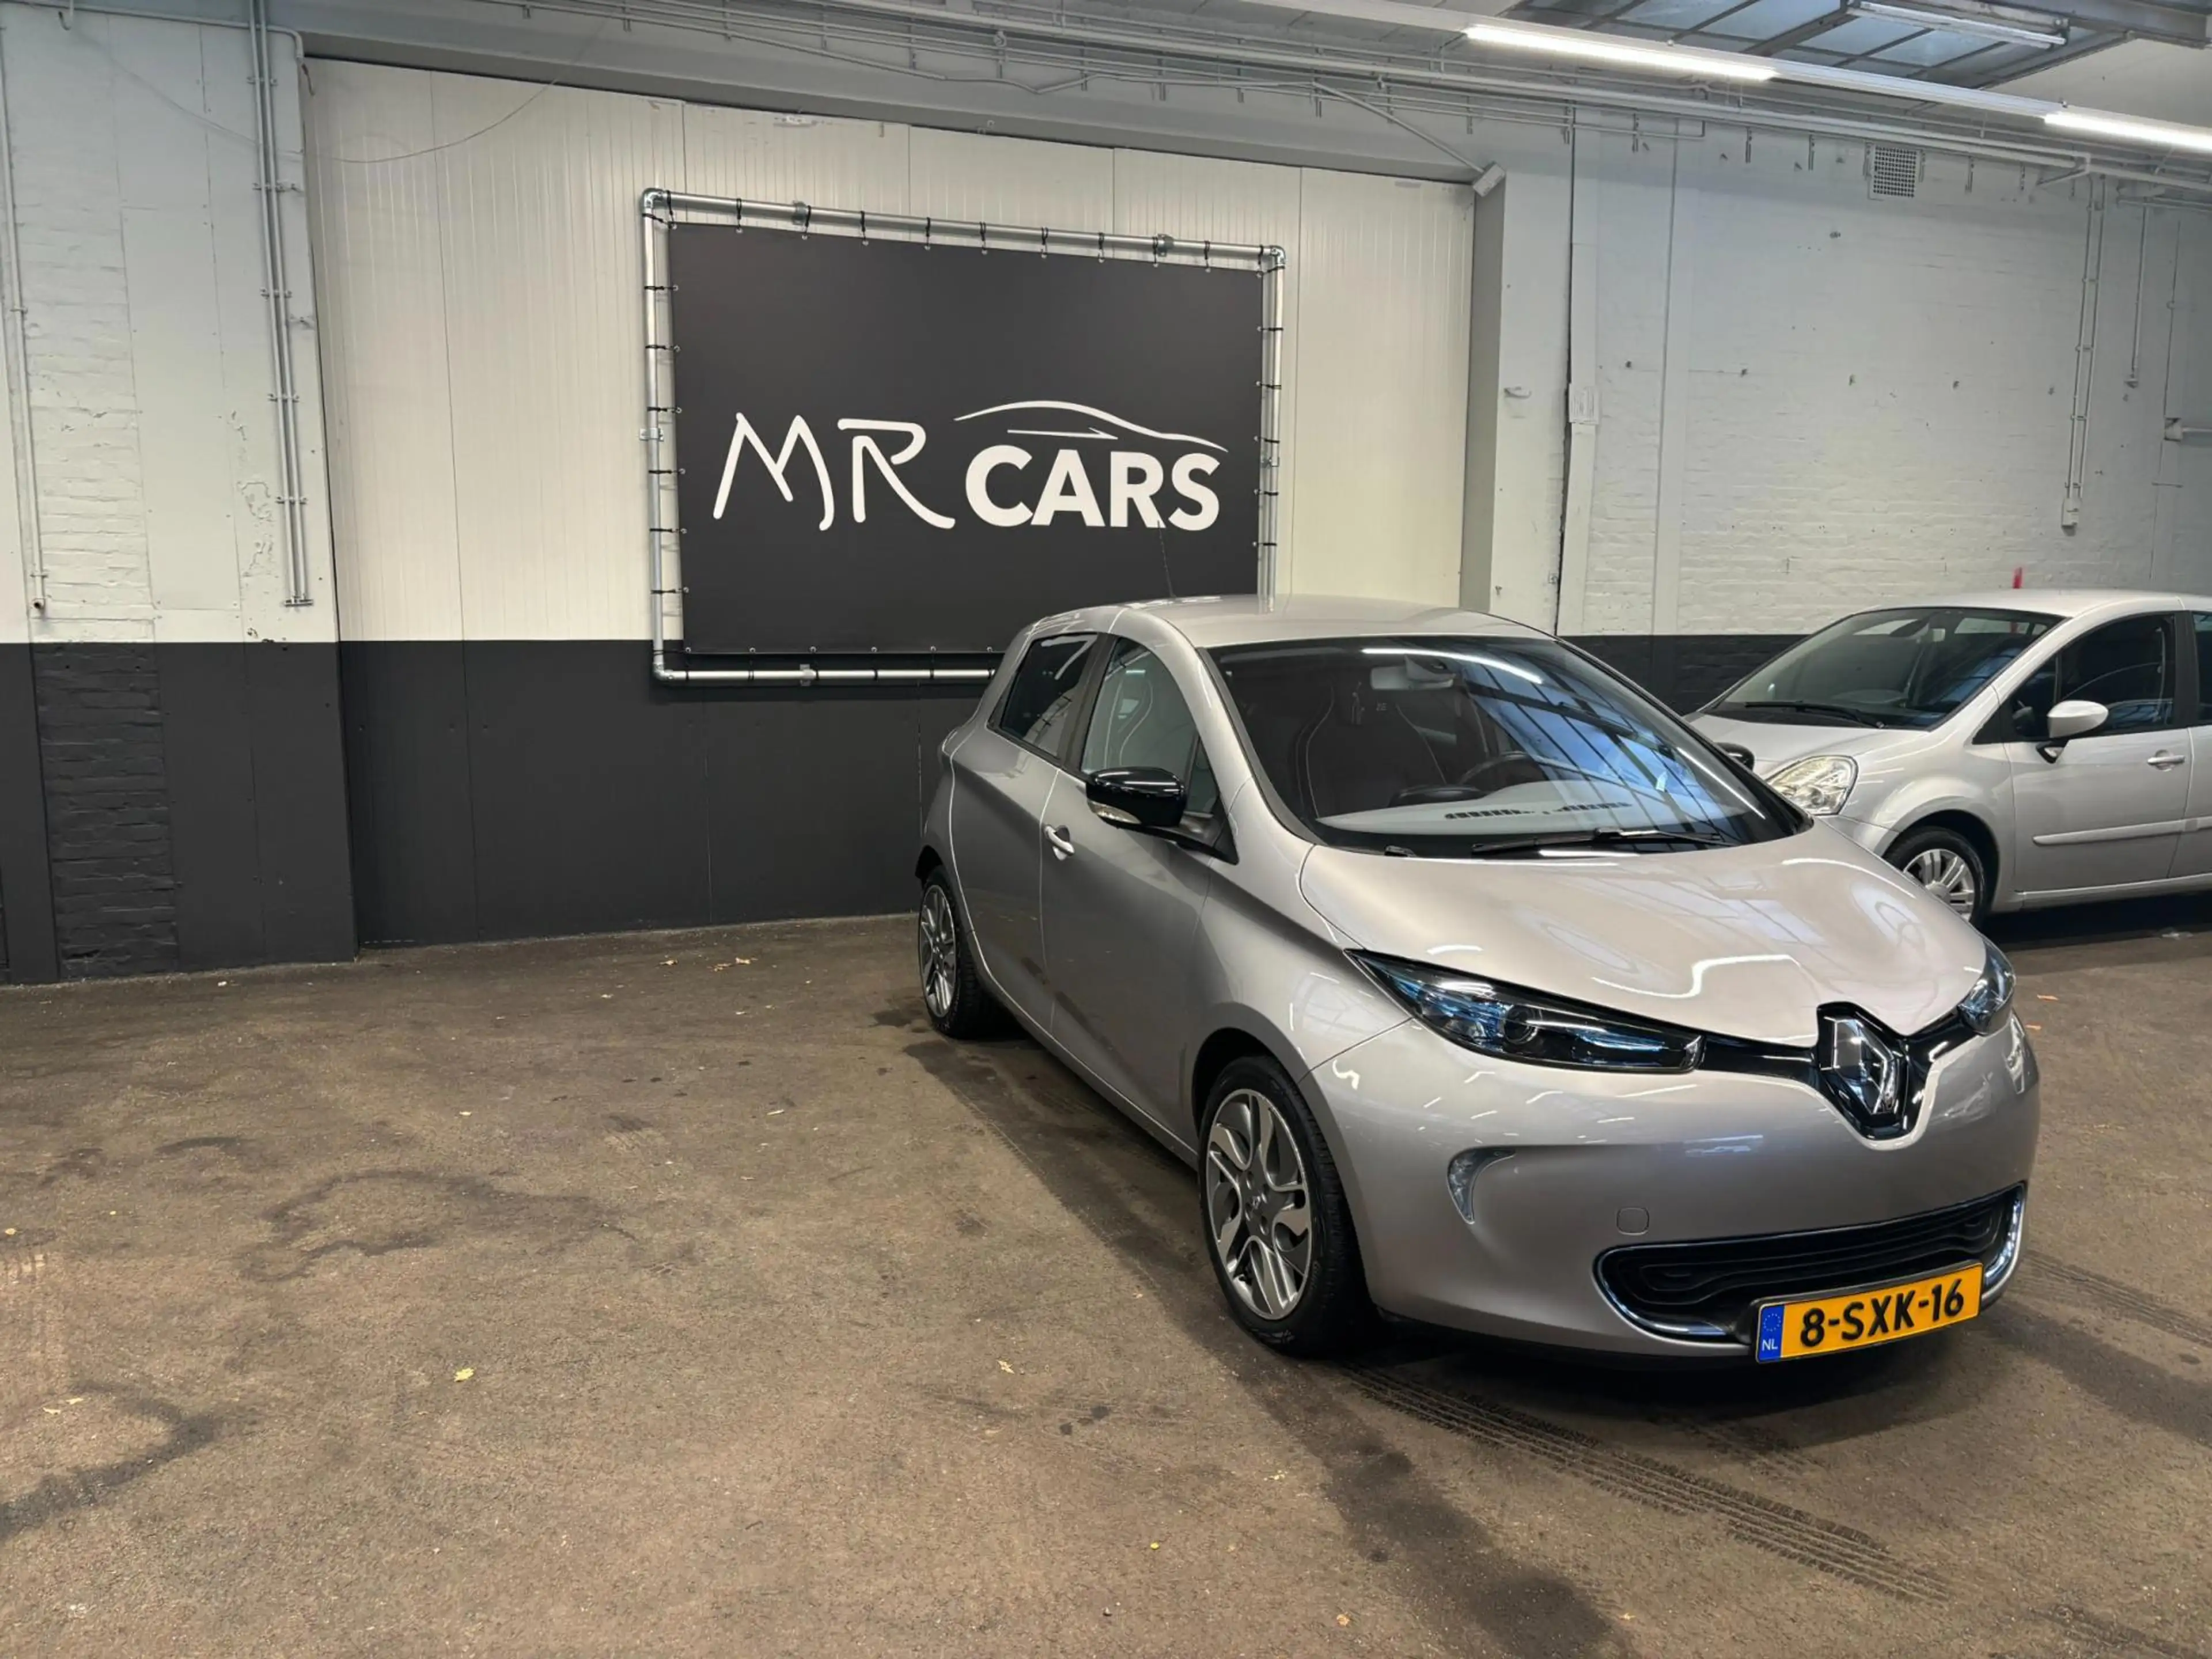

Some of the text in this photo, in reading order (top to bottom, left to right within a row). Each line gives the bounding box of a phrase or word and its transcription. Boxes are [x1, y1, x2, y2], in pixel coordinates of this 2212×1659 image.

[713, 412, 1220, 531] MR CARS
[1762, 1339, 1778, 1351] NL
[1800, 1279, 1964, 1347] 8-SXK-16
